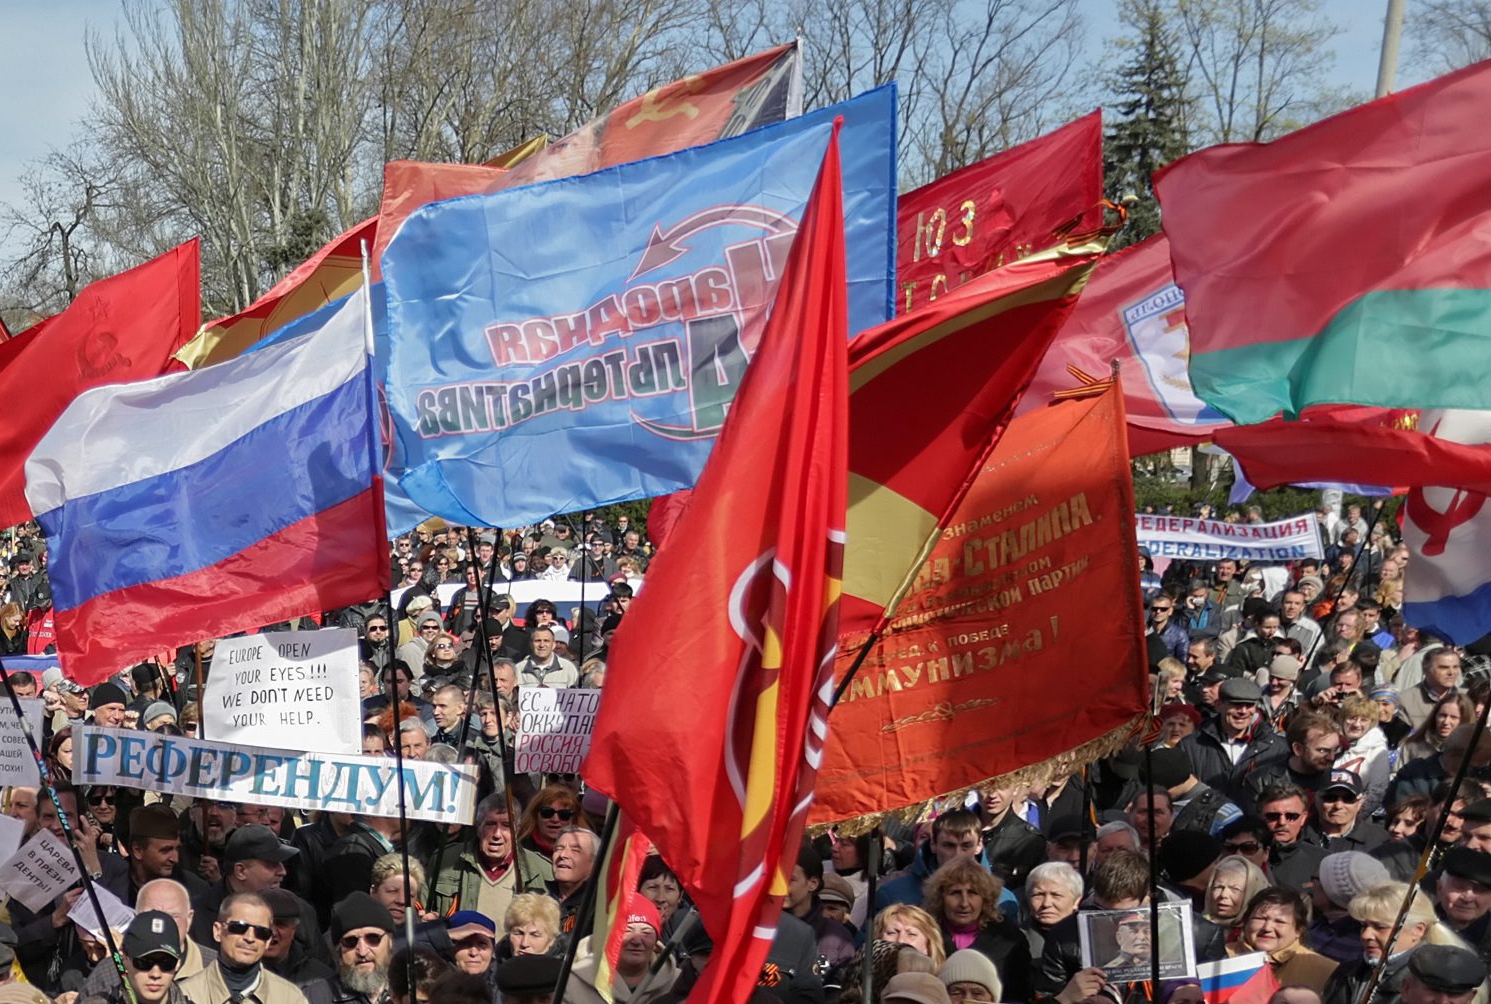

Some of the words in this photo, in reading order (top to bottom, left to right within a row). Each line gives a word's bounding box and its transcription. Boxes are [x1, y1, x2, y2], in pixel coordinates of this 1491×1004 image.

[1136, 516, 1308, 540] ЕДЕРАЛИЗАЦИЯ
[228, 645, 263, 665] EUROPE
[278, 643, 311, 658] OPEN
[235, 670, 261, 685] YOUR
[222, 693, 242, 709] WE
[293, 686, 334, 702] NEED
[553, 692, 600, 713] НАТО
[233, 713, 267, 728] YOUR
[1, 735, 27, 745] СОВЕС
[518, 734, 585, 754] РОССИЯ
[84, 733, 462, 814] РЕФЕРЕНДУМ!
[517, 753, 583, 773] ОСВОБО
[28, 850, 36, 859] В
[35, 858, 65, 885] ПРЕЗИ
[40, 840, 77, 875] ЦАРЕВА
